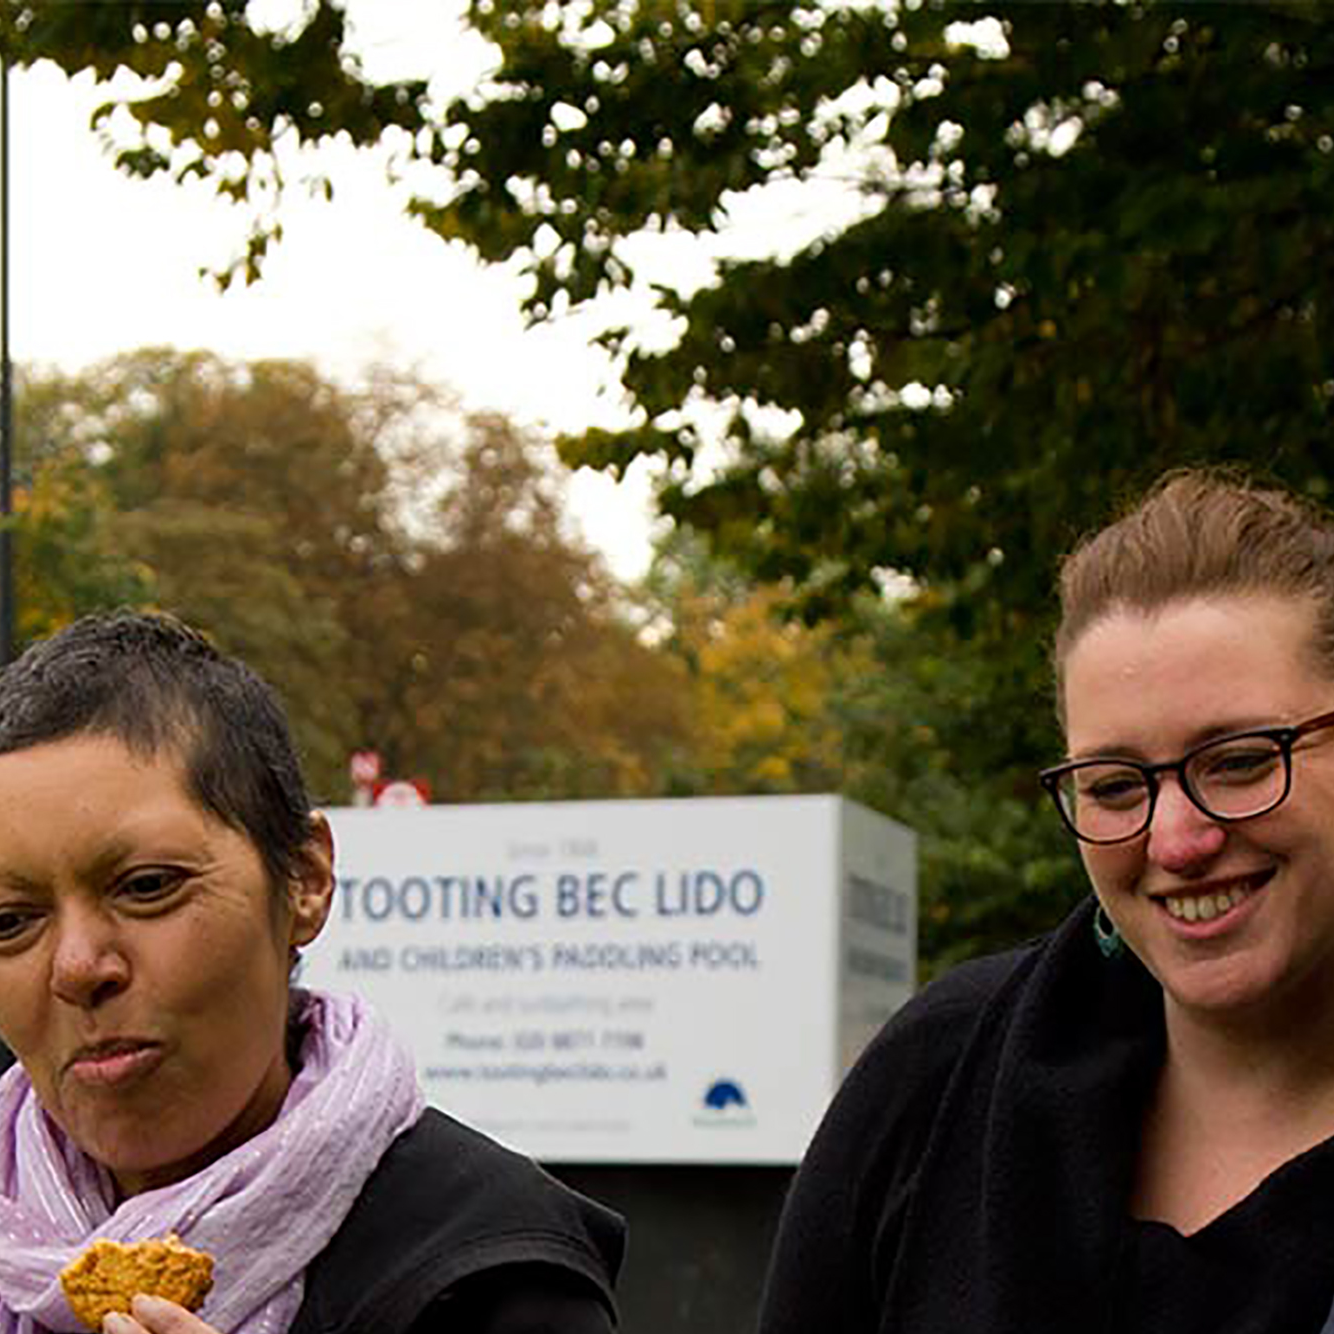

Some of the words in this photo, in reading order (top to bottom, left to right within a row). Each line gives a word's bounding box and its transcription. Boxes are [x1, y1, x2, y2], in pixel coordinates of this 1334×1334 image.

[339, 873, 539, 923] TOOTING
[555, 871, 639, 920] BEC
[655, 868, 765, 918] LIDO
[338, 946, 392, 972] AND
[400, 944, 544, 972] CHILDREN'S
[552, 942, 682, 971] PADDLING
[688, 941, 760, 970] POOL
